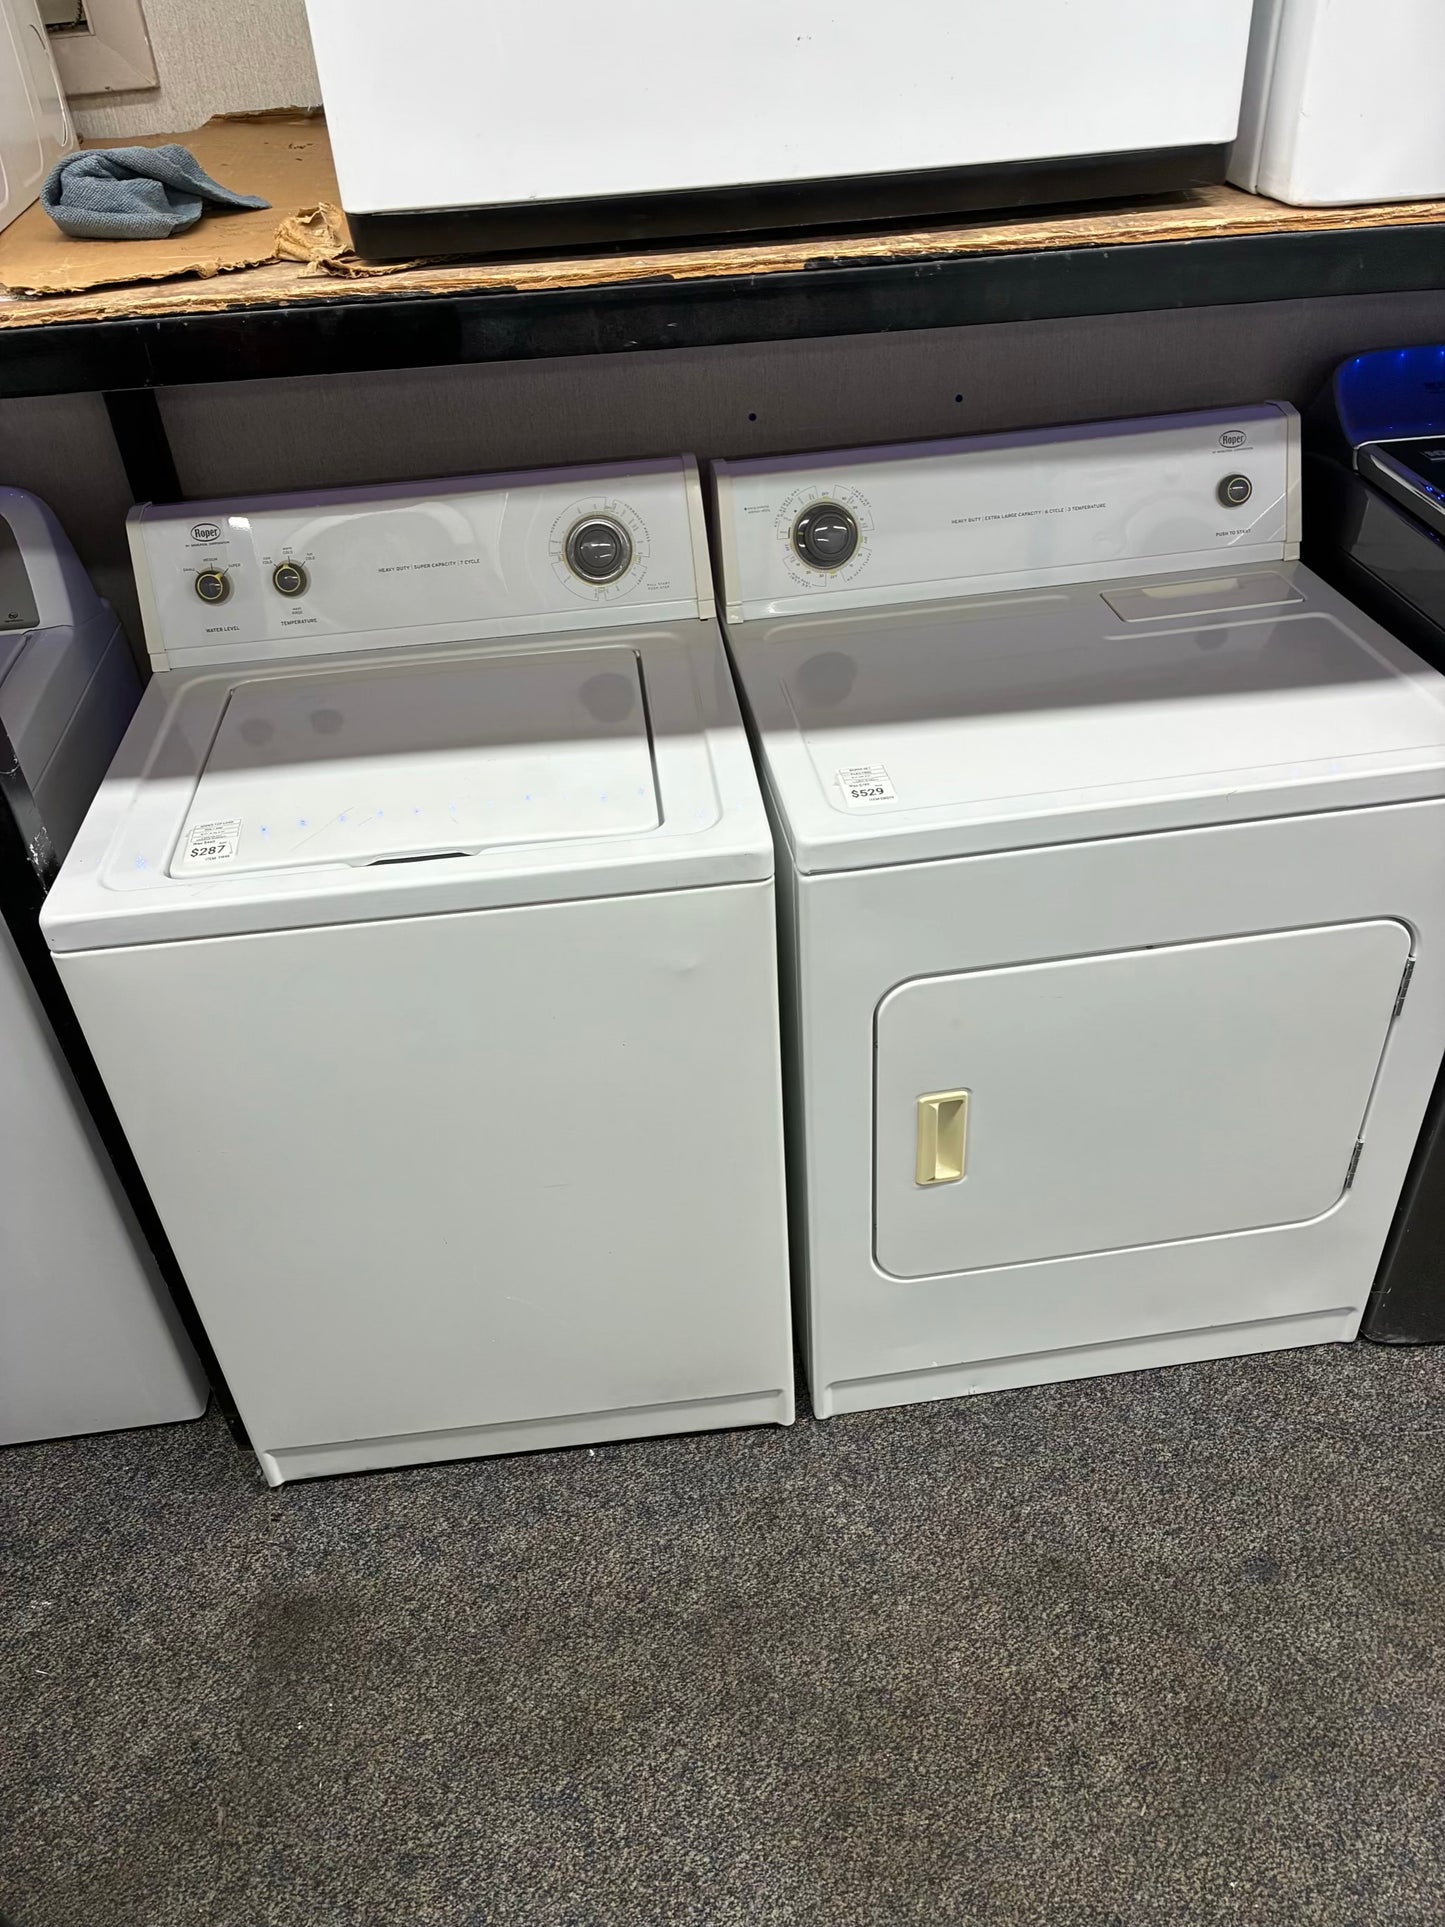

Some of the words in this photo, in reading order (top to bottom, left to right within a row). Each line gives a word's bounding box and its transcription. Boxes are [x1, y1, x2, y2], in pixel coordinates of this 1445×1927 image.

[1222, 435, 1244, 446] Roper
[1018, 510, 1041, 518] CAPACITY
[1072, 502, 1106, 511] TEMPERATURE
[194, 528, 218, 539] Roper
[280, 618, 318, 626] TEMPERATURE
[851, 787, 884, 798] $529
[190, 845, 226, 858] $287
